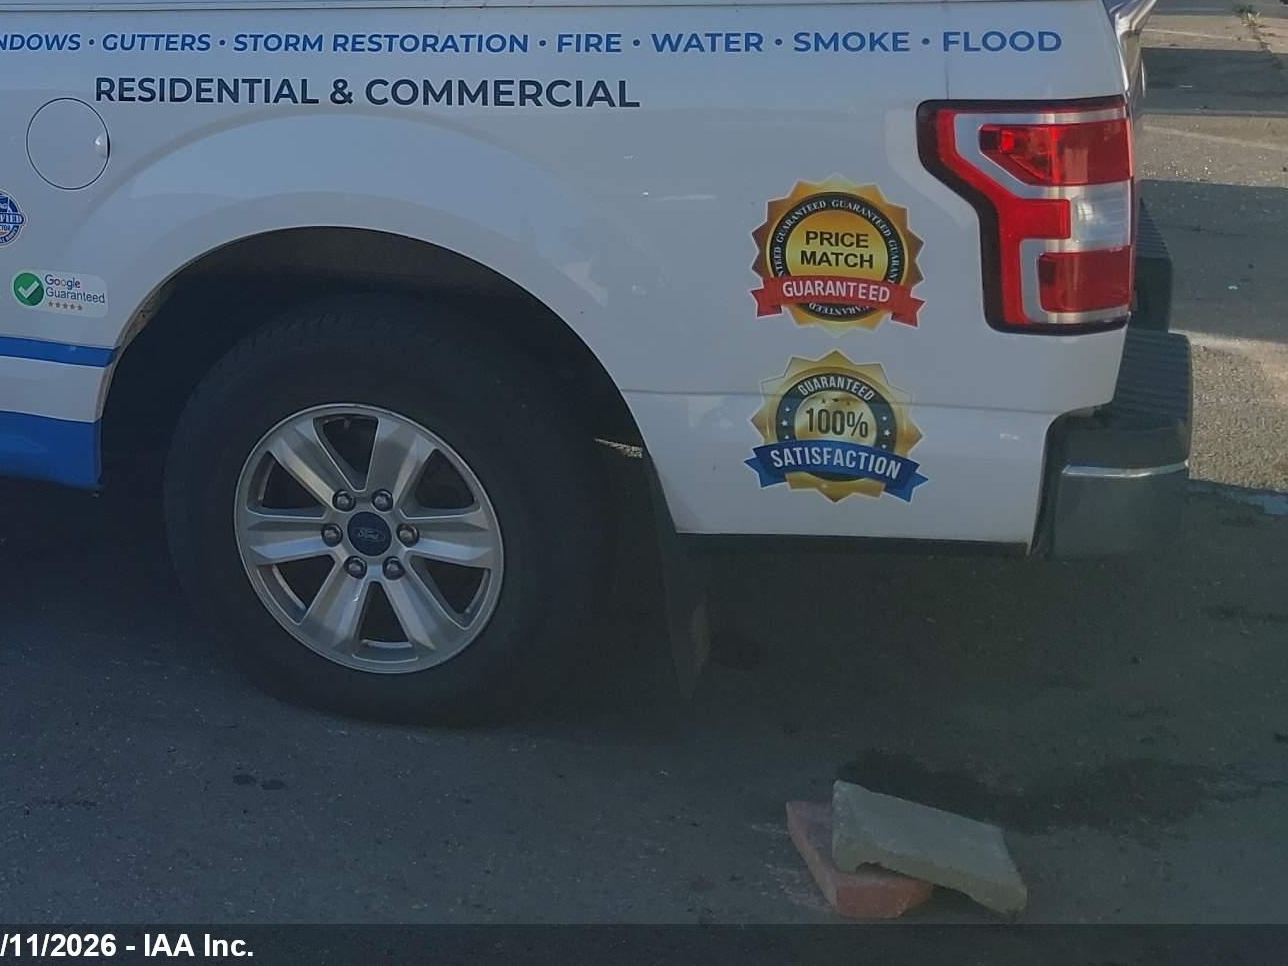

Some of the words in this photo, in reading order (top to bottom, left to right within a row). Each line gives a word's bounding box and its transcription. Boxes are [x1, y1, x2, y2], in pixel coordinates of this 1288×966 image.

[102, 33, 211, 51] GUTTERS
[233, 33, 323, 52] STORM
[332, 33, 528, 53] RESTORATION
[557, 33, 622, 53] FIRE
[651, 32, 763, 53] WATER
[793, 31, 910, 52] SMOKE
[942, 31, 1062, 52] FLOOD
[95, 77, 319, 105] RESIDENTIAL
[329, 78, 354, 105] &
[365, 78, 641, 108] COMMERCIAL
[777, 200, 826, 243] GUARANTEED
[831, 199, 890, 238] GUARANTEED
[805, 230, 869, 249] PRICE
[800, 250, 874, 269] MATCH
[45, 274, 81, 289] Google
[782, 280, 890, 303] GUARANTEED
[45, 288, 105, 304] Guaranteed
[798, 376, 875, 402] GUARANTEED
[806, 407, 869, 438] 100%
[770, 446, 902, 480] SATISFACTION
